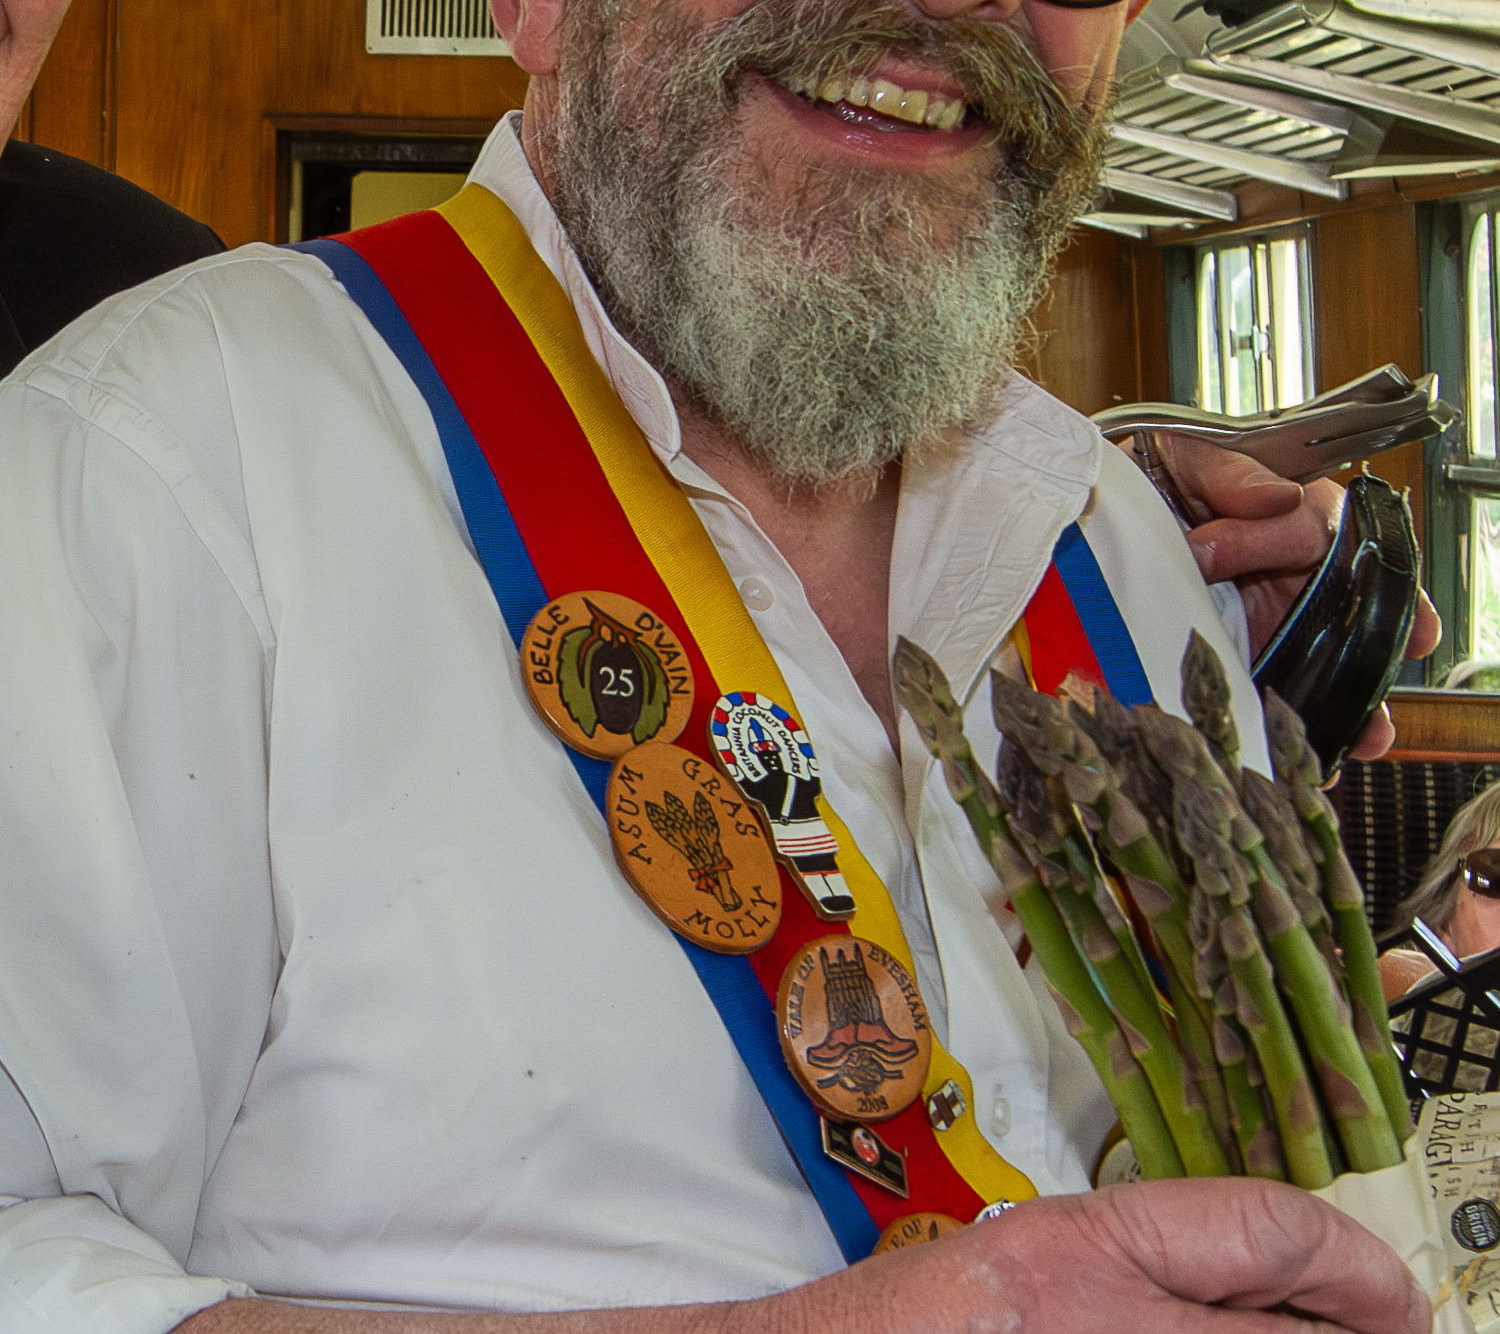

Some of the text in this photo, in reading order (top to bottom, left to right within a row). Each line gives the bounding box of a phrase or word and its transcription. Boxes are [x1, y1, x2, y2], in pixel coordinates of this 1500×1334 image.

[530, 604, 691, 695] BELLE D'VAIN
[599, 667, 635, 697] 25
[616, 758, 760, 866] ASUM GRAS
[683, 884, 777, 939] MOLLY
[867, 944, 927, 1032] EVESHAM
[1464, 1204, 1490, 1247] ORIGIN
